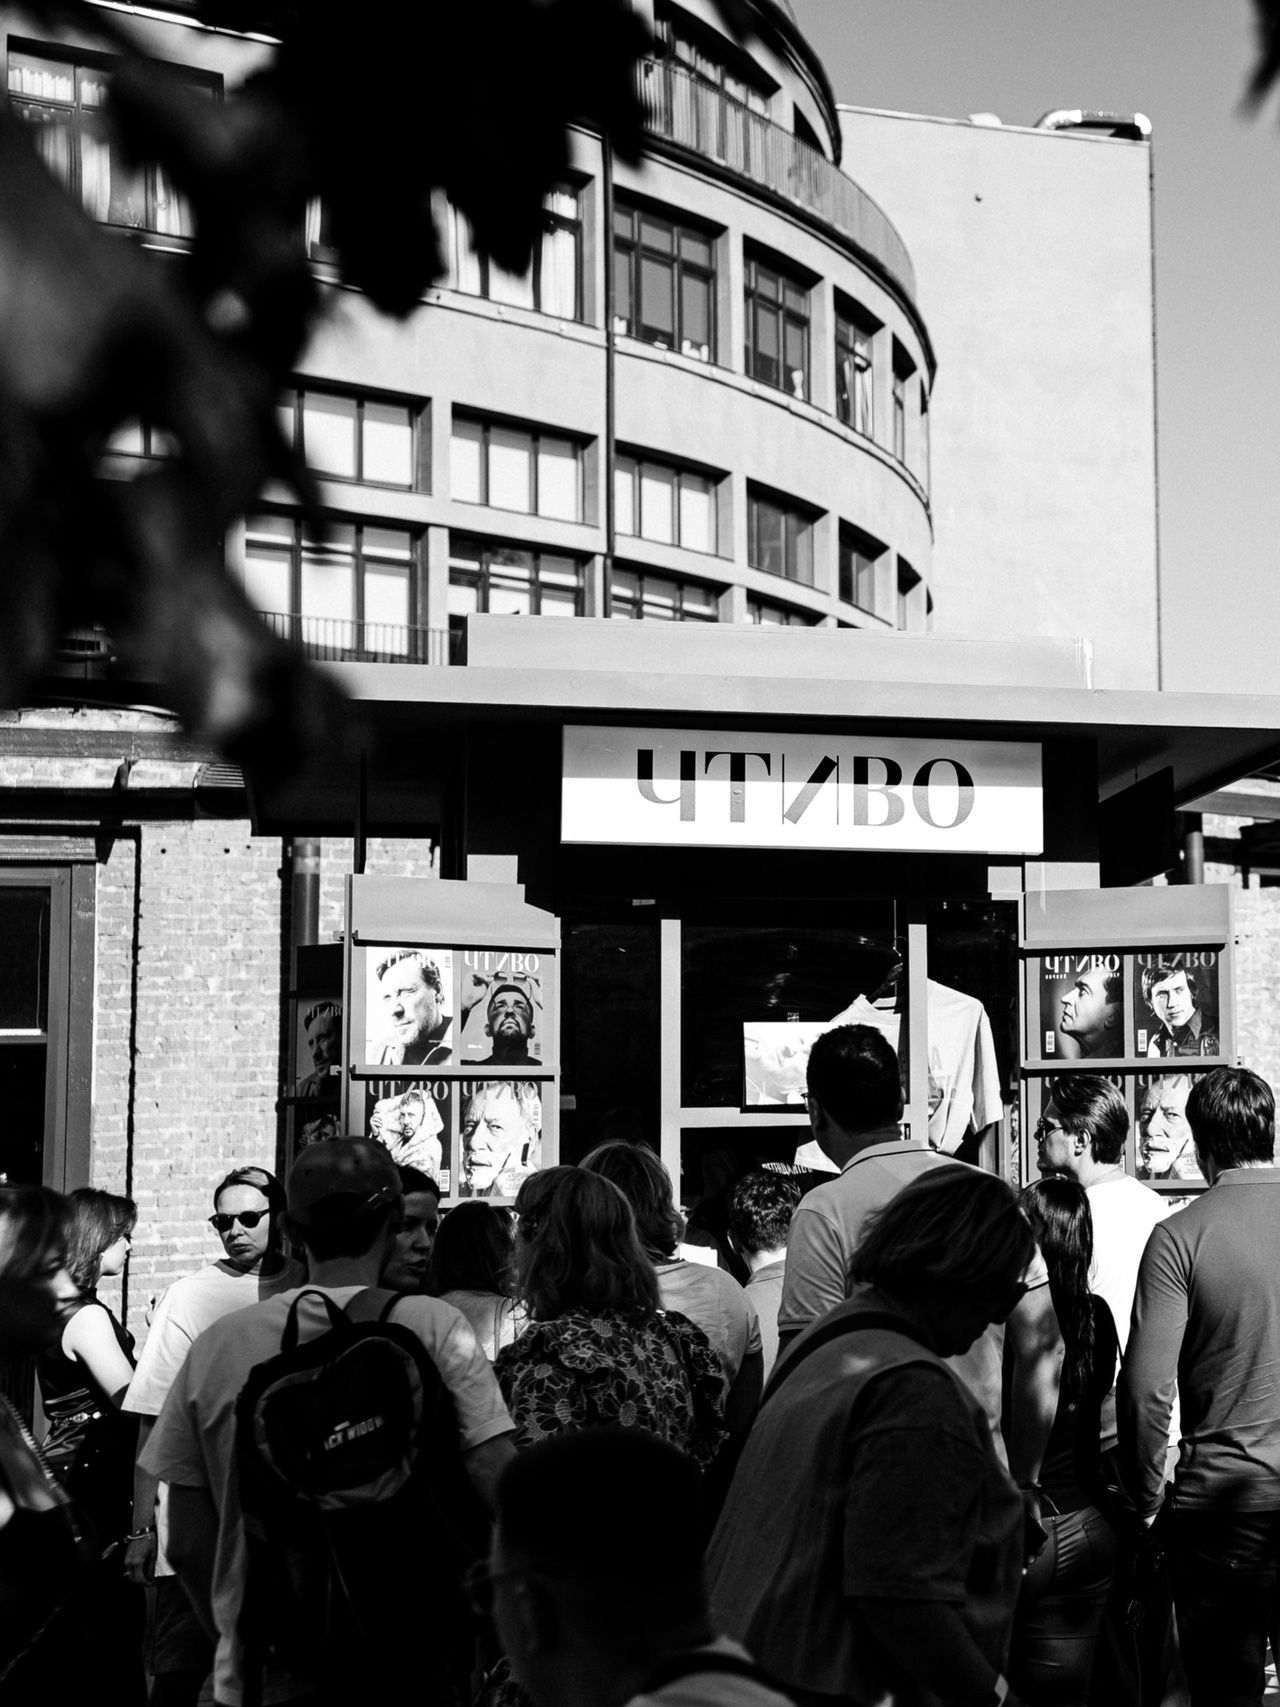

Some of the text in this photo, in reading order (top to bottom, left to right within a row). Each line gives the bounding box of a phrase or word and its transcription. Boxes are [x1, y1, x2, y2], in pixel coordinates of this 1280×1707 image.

[637, 748, 975, 829] ЧТИВО
[464, 951, 540, 973] ЧТИВО
[1045, 954, 1120, 973] ЧТИВО
[1137, 952, 1216, 968] ЧТИВО
[369, 1080, 449, 1100] ЧТИВО
